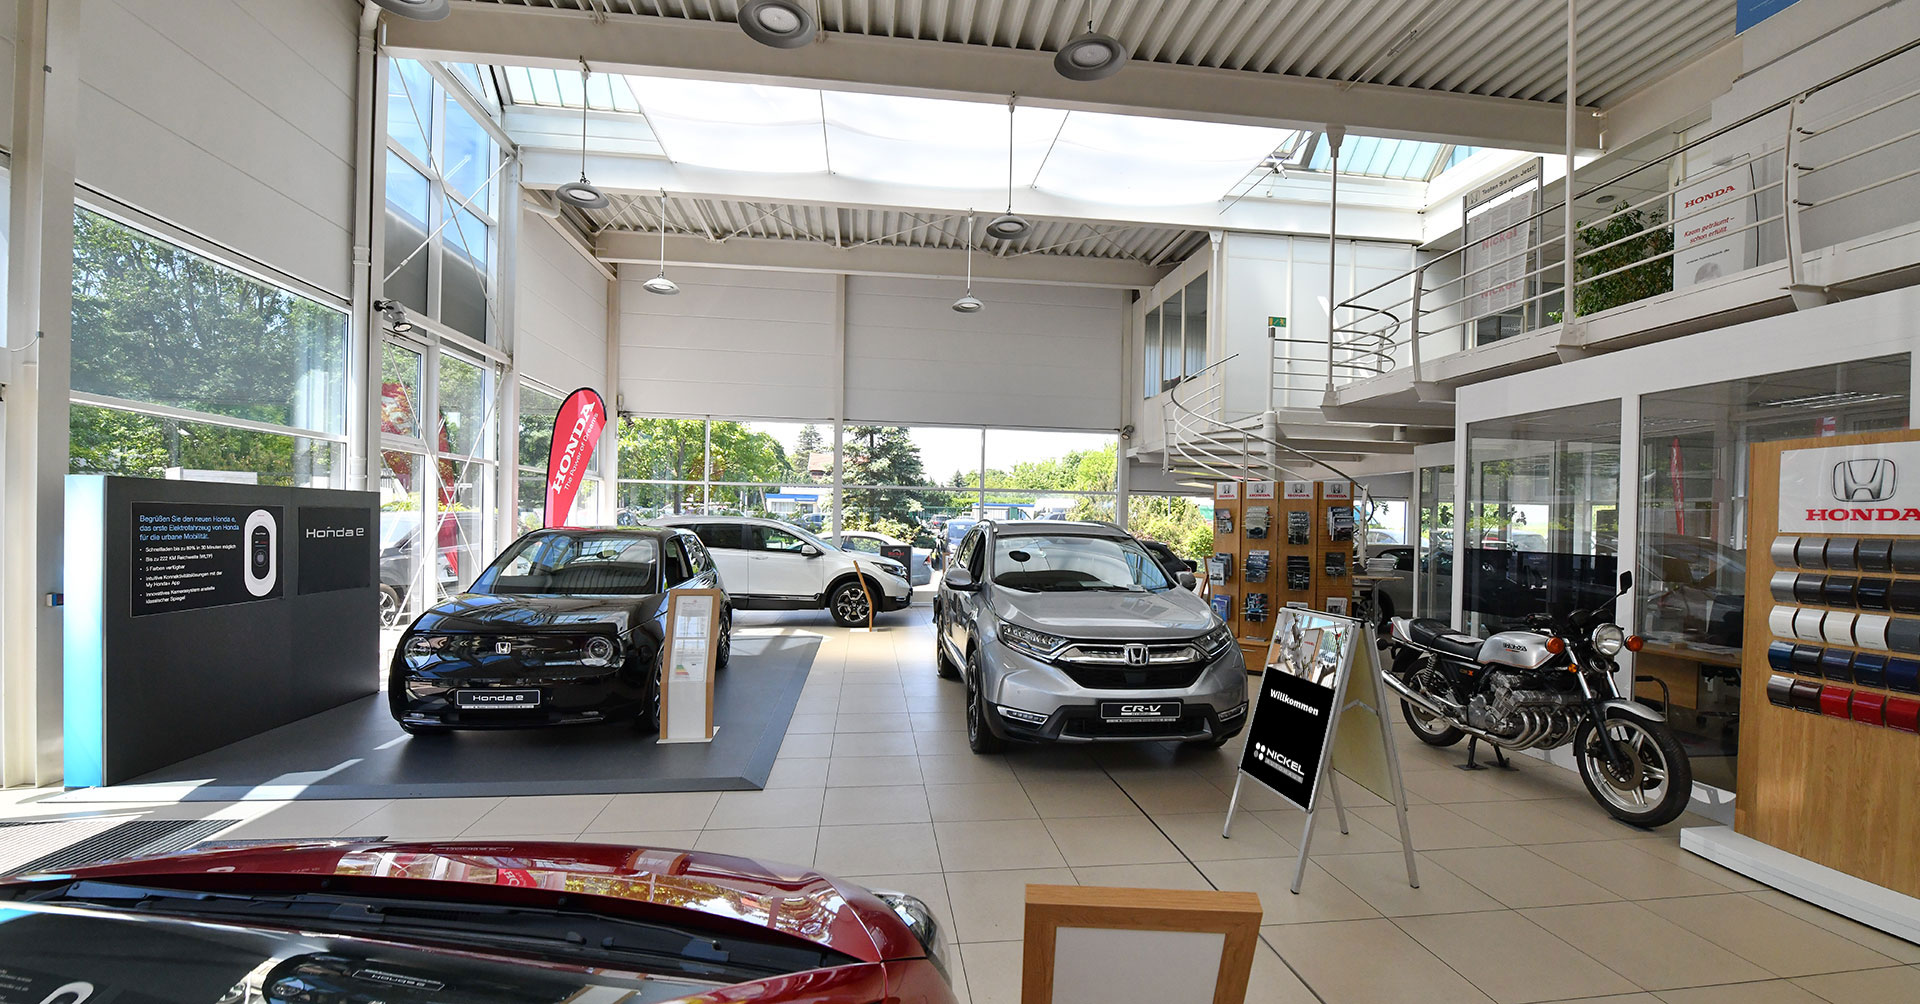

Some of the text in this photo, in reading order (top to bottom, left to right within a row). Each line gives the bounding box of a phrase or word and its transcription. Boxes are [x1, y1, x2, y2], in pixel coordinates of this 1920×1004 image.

[1684, 185, 1735, 208] HONDA
[551, 401, 596, 494] HONDA
[564, 412, 599, 490] The Power of Dreams
[139, 514, 170, 524] Begrüßen
[1805, 508, 1920, 521] HONDA
[306, 527, 365, 538] Honda e
[472, 694, 513, 702] Honda
[1270, 688, 1319, 717] Willkommen
[1121, 704, 1161, 712] CR-V
[1266, 747, 1305, 776] NICKEL
